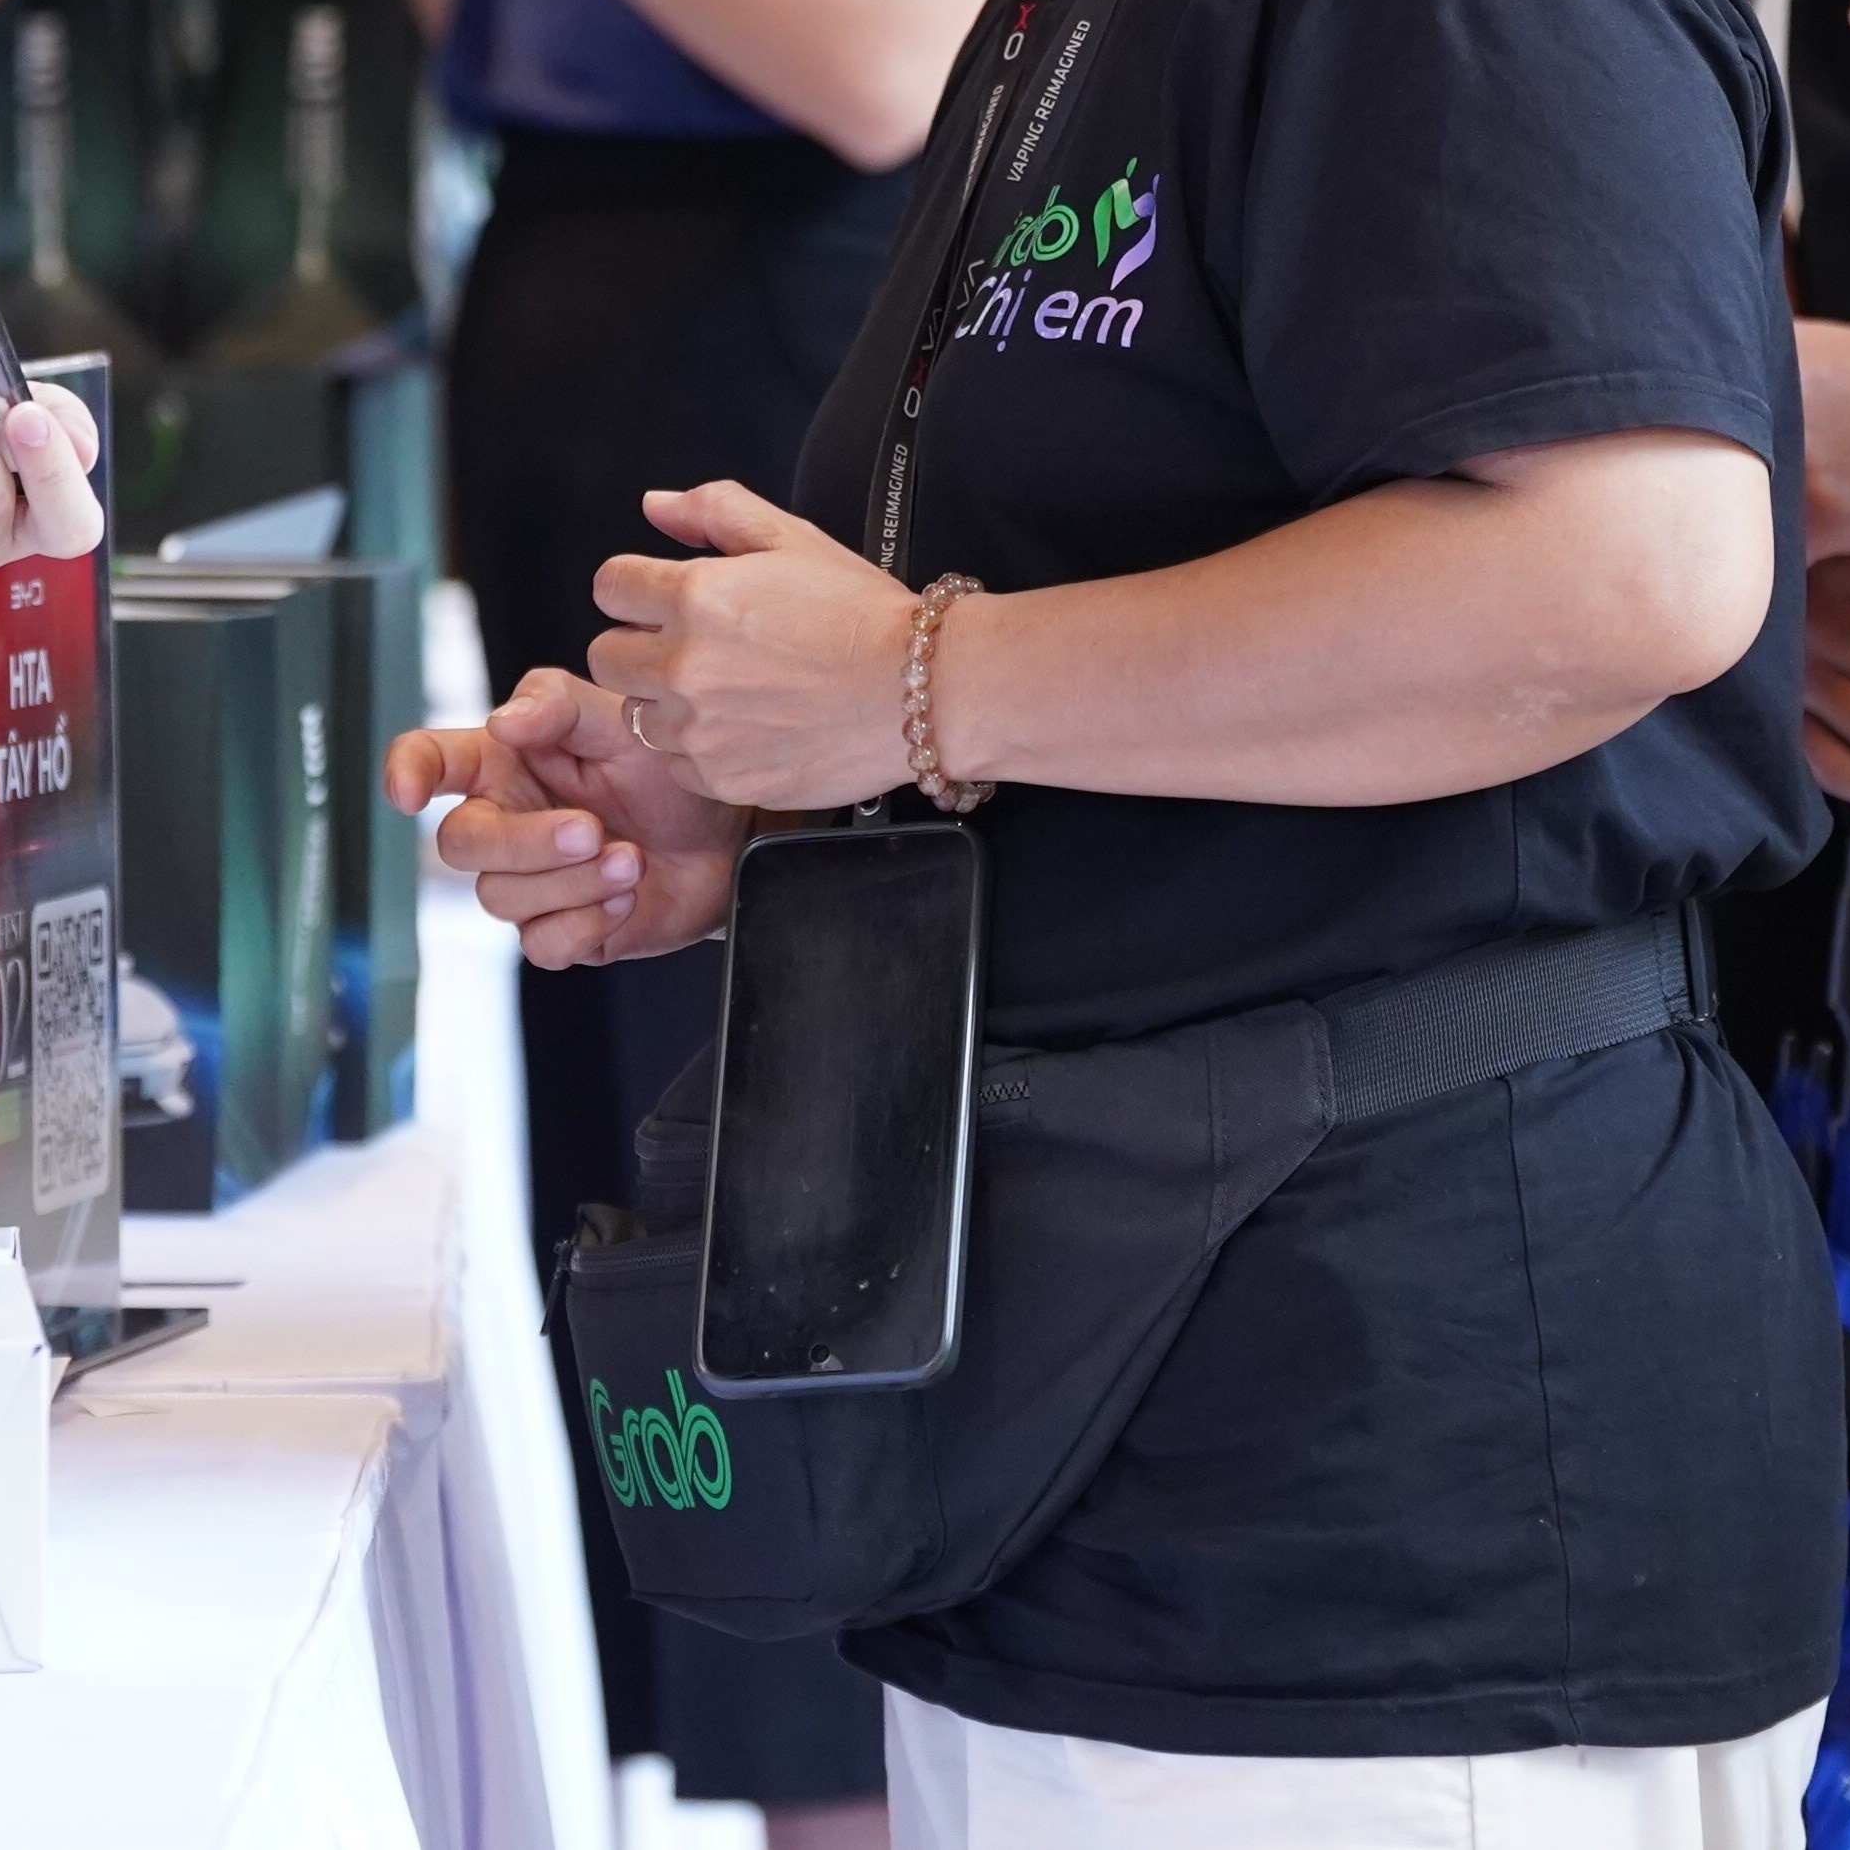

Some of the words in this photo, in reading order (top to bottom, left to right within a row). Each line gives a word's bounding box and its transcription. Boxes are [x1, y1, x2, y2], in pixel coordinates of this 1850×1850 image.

[1007, 120, 1044, 183] VAPING
[1034, 19, 1091, 122] REIMAGINED
[1034, 290, 1144, 348] em
[882, 443, 909, 539] REIMAGINED
[9, 649, 54, 710] HTA
[37, 711, 72, 795] HỒ
[589, 1369, 733, 1511] Grab
